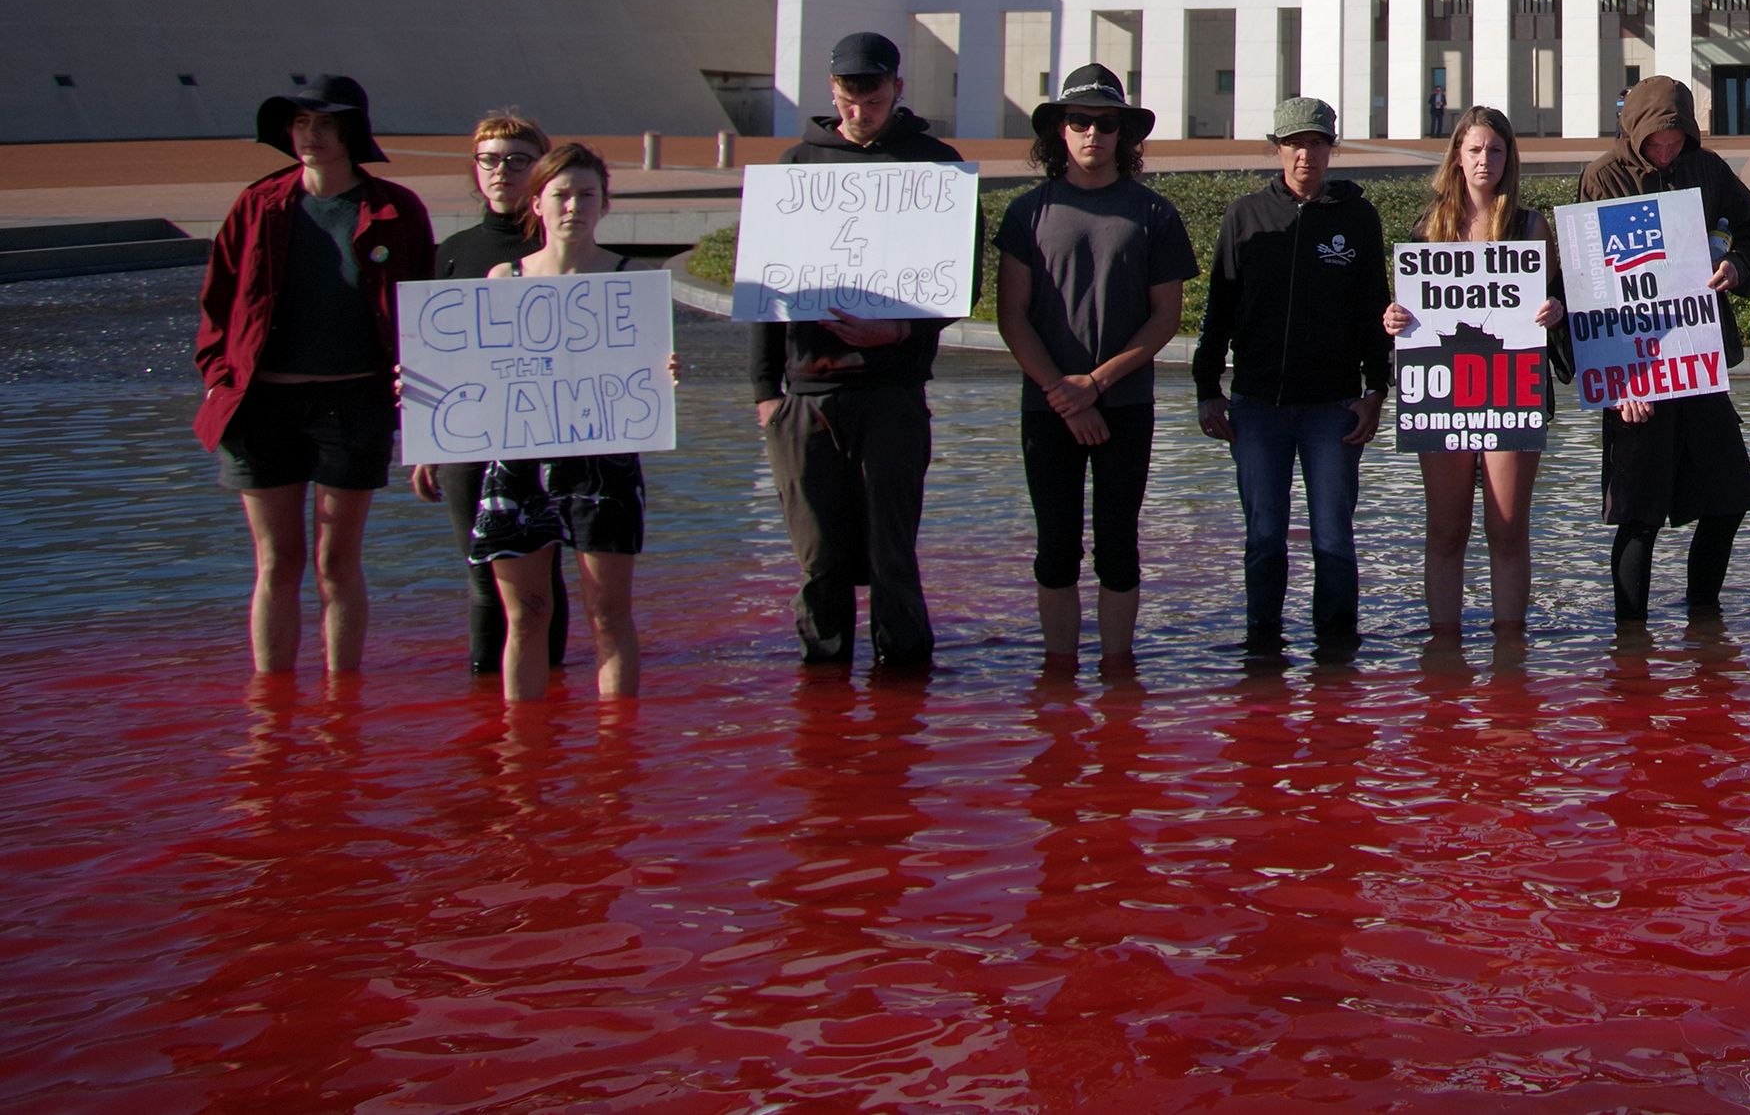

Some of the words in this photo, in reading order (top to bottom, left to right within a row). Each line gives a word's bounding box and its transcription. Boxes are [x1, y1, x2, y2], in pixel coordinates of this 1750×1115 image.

[776, 168, 958, 214] JUSTICE
[830, 216, 868, 267] 4
[1583, 212, 1600, 240] FOR
[1605, 228, 1662, 253] ALP
[1399, 248, 1475, 277] stop
[1484, 245, 1541, 274] the
[1587, 242, 1608, 300] HIGGINS
[1421, 281, 1521, 310] boats
[1620, 272, 1658, 302] NO
[418, 280, 637, 352] CLOSE
[1572, 294, 1715, 341] OPPOSITION
[1634, 336, 1661, 358] to
[490, 357, 554, 379] THE
[1582, 351, 1720, 403] CRUELTY
[432, 368, 661, 453] CAMPS
[1400, 409, 1543, 430] somewhere
[1445, 430, 1498, 451] else
